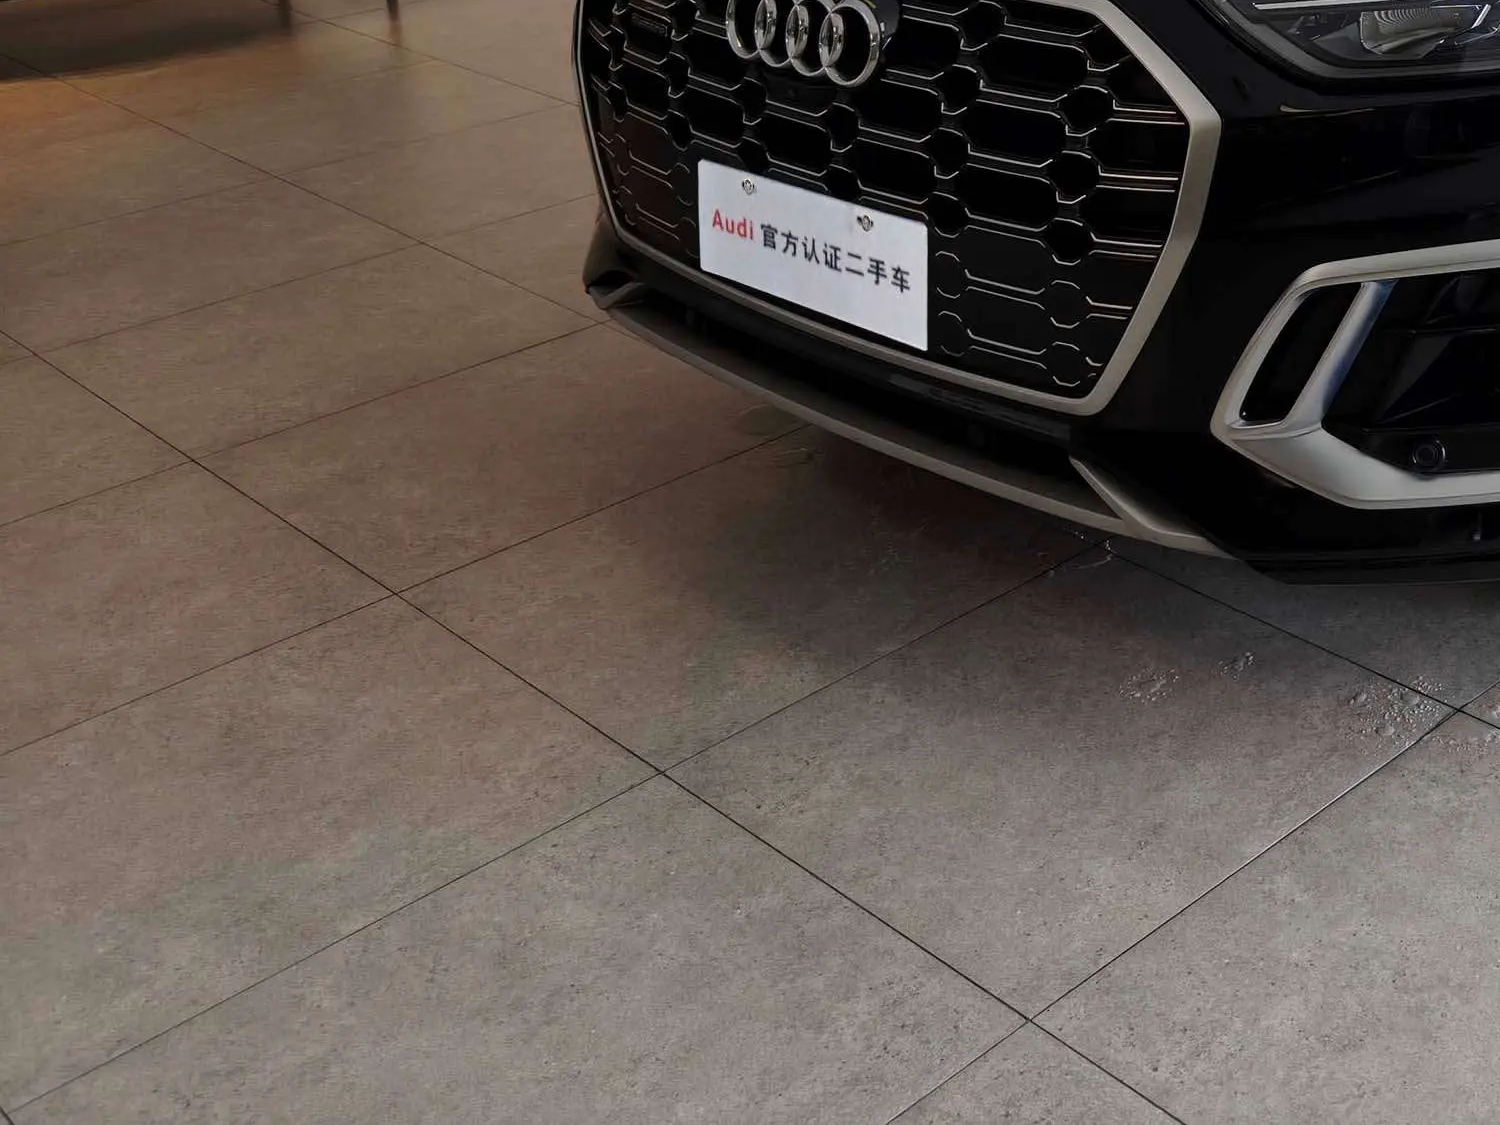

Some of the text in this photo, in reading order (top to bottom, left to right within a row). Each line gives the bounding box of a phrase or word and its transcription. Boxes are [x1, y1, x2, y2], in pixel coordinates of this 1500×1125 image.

[712, 209, 910, 293] Audi 官方认证二手车
